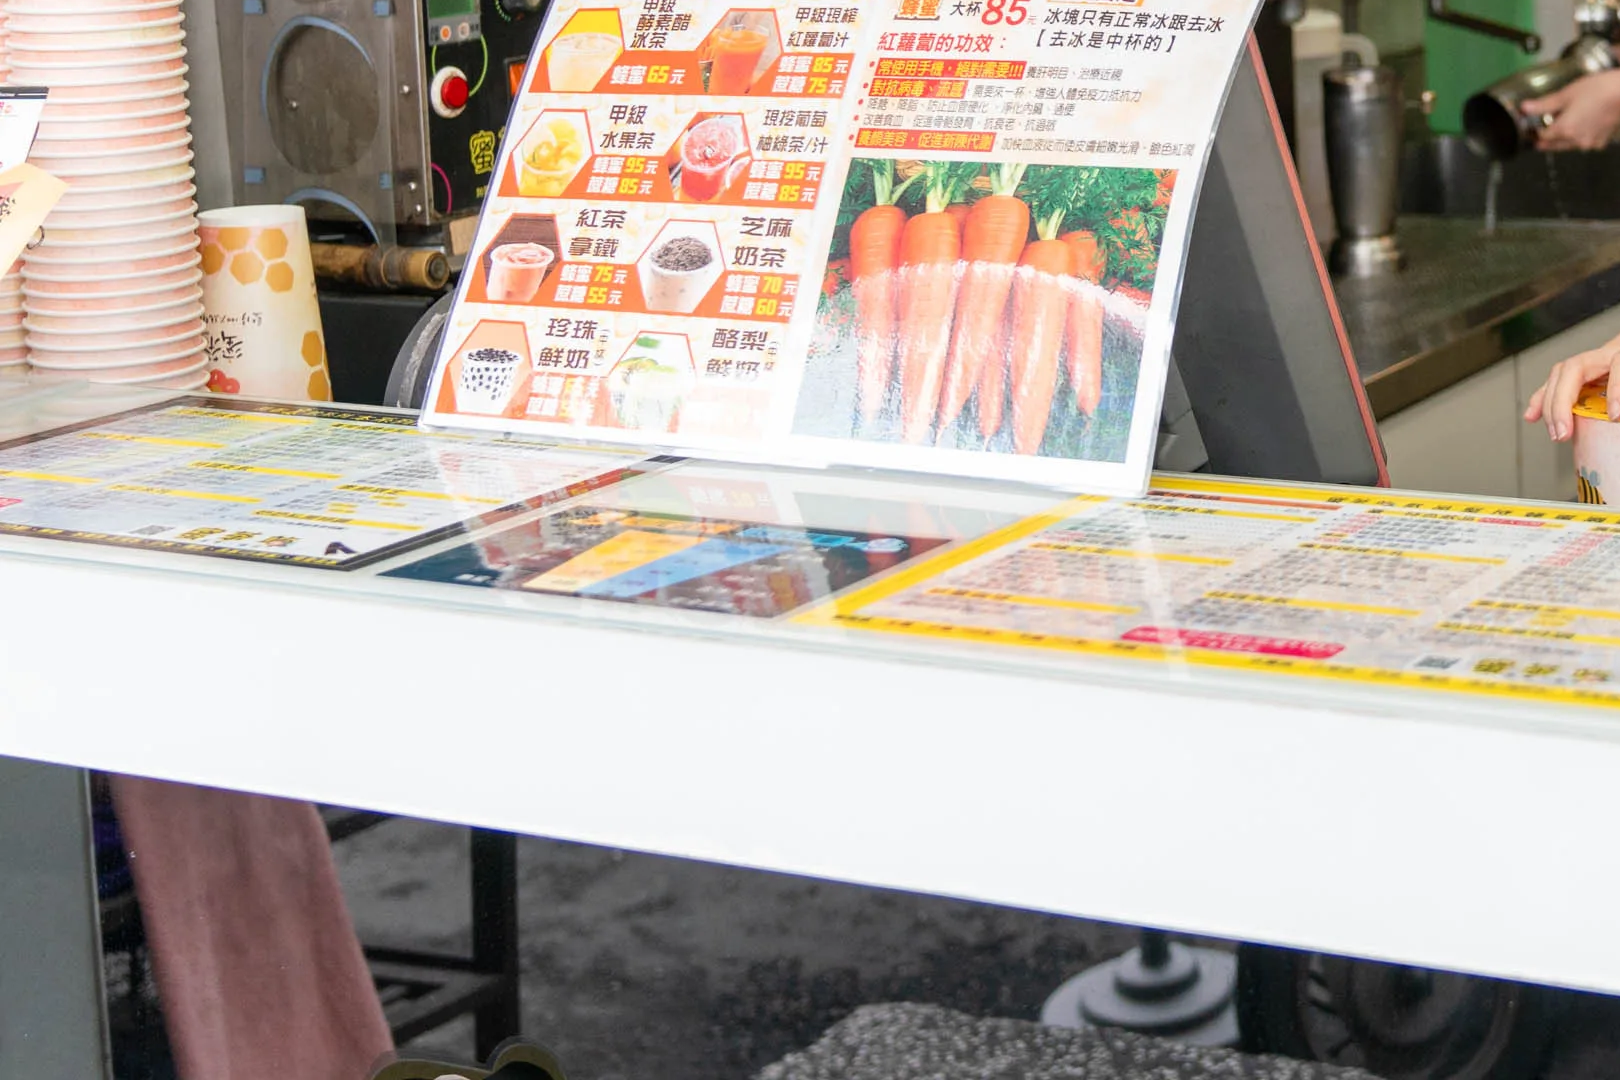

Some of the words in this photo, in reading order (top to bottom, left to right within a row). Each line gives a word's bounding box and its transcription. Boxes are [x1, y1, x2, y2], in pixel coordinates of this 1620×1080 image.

[794, 6, 860, 24] 甲級現榨
[950, 0, 982, 18] 大杯
[635, 12, 693, 32] 酵素醋
[1043, 7, 1225, 34] 冰塊只有正常冰跟去冰
[628, 32, 668, 49] 冰茶
[785, 31, 851, 50] 紅蘿蔔汁
[607, 104, 649, 126] 甲級
[762, 108, 829, 129] 現挖葡萄
[598, 130, 657, 151] 水果茶
[574, 208, 629, 230] 紅茶
[739, 215, 796, 238] 芝麻
[567, 236, 620, 259] 拿鐵
[731, 245, 788, 268] 奶茶
[545, 317, 599, 341] 珍珠
[711, 327, 769, 352] 酪梨
[537, 346, 590, 370] 鮮奶
